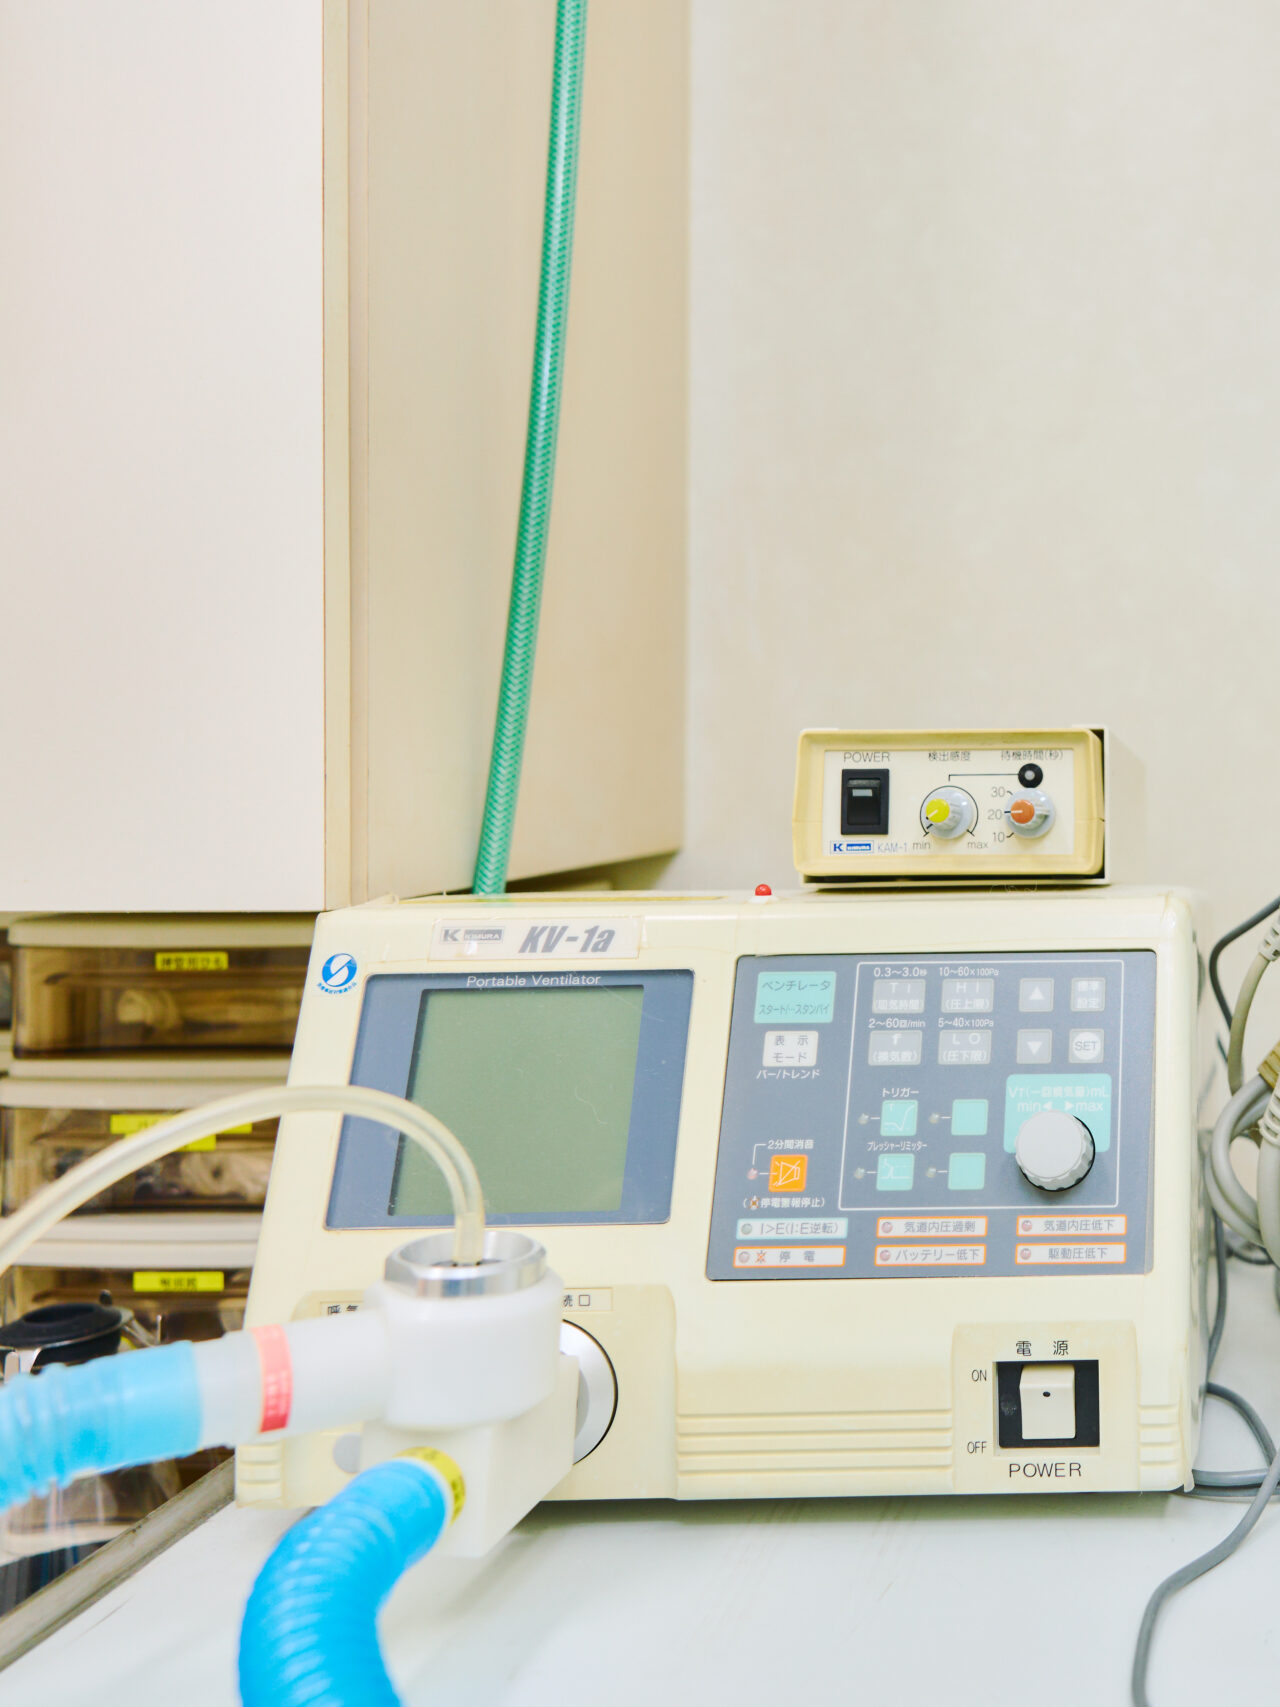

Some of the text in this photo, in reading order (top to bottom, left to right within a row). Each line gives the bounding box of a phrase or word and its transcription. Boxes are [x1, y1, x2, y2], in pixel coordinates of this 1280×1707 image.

[843, 751, 890, 763] POWER
[928, 751, 972, 761] 検出感度
[991, 786, 1006, 798] 30
[987, 809, 1002, 821] 20
[993, 831, 1005, 843] 10
[877, 843, 909, 853] KAM-1
[912, 841, 931, 850] min
[967, 841, 989, 850] max
[518, 925, 616, 953] KV-1a
[466, 974, 602, 988] Portable Ventilator
[761, 980, 831, 991] ベンチレータ
[1074, 1040, 1098, 1051] SET
[772, 1052, 807, 1062] モード
[882, 1088, 919, 1097] トリガー
[1017, 1101, 1103, 1113] min max
[768, 1139, 814, 1149] 2分間消音
[904, 1220, 976, 1233] 気道内圧過剰
[1044, 1219, 1115, 1232] 気道内圧低下
[896, 1248, 980, 1262] バッテリー低下
[1048, 1247, 1108, 1260] 駆動圧低下
[971, 1370, 987, 1381] ON
[967, 1441, 987, 1453] OFF
[1009, 1462, 1082, 1478] POWER
